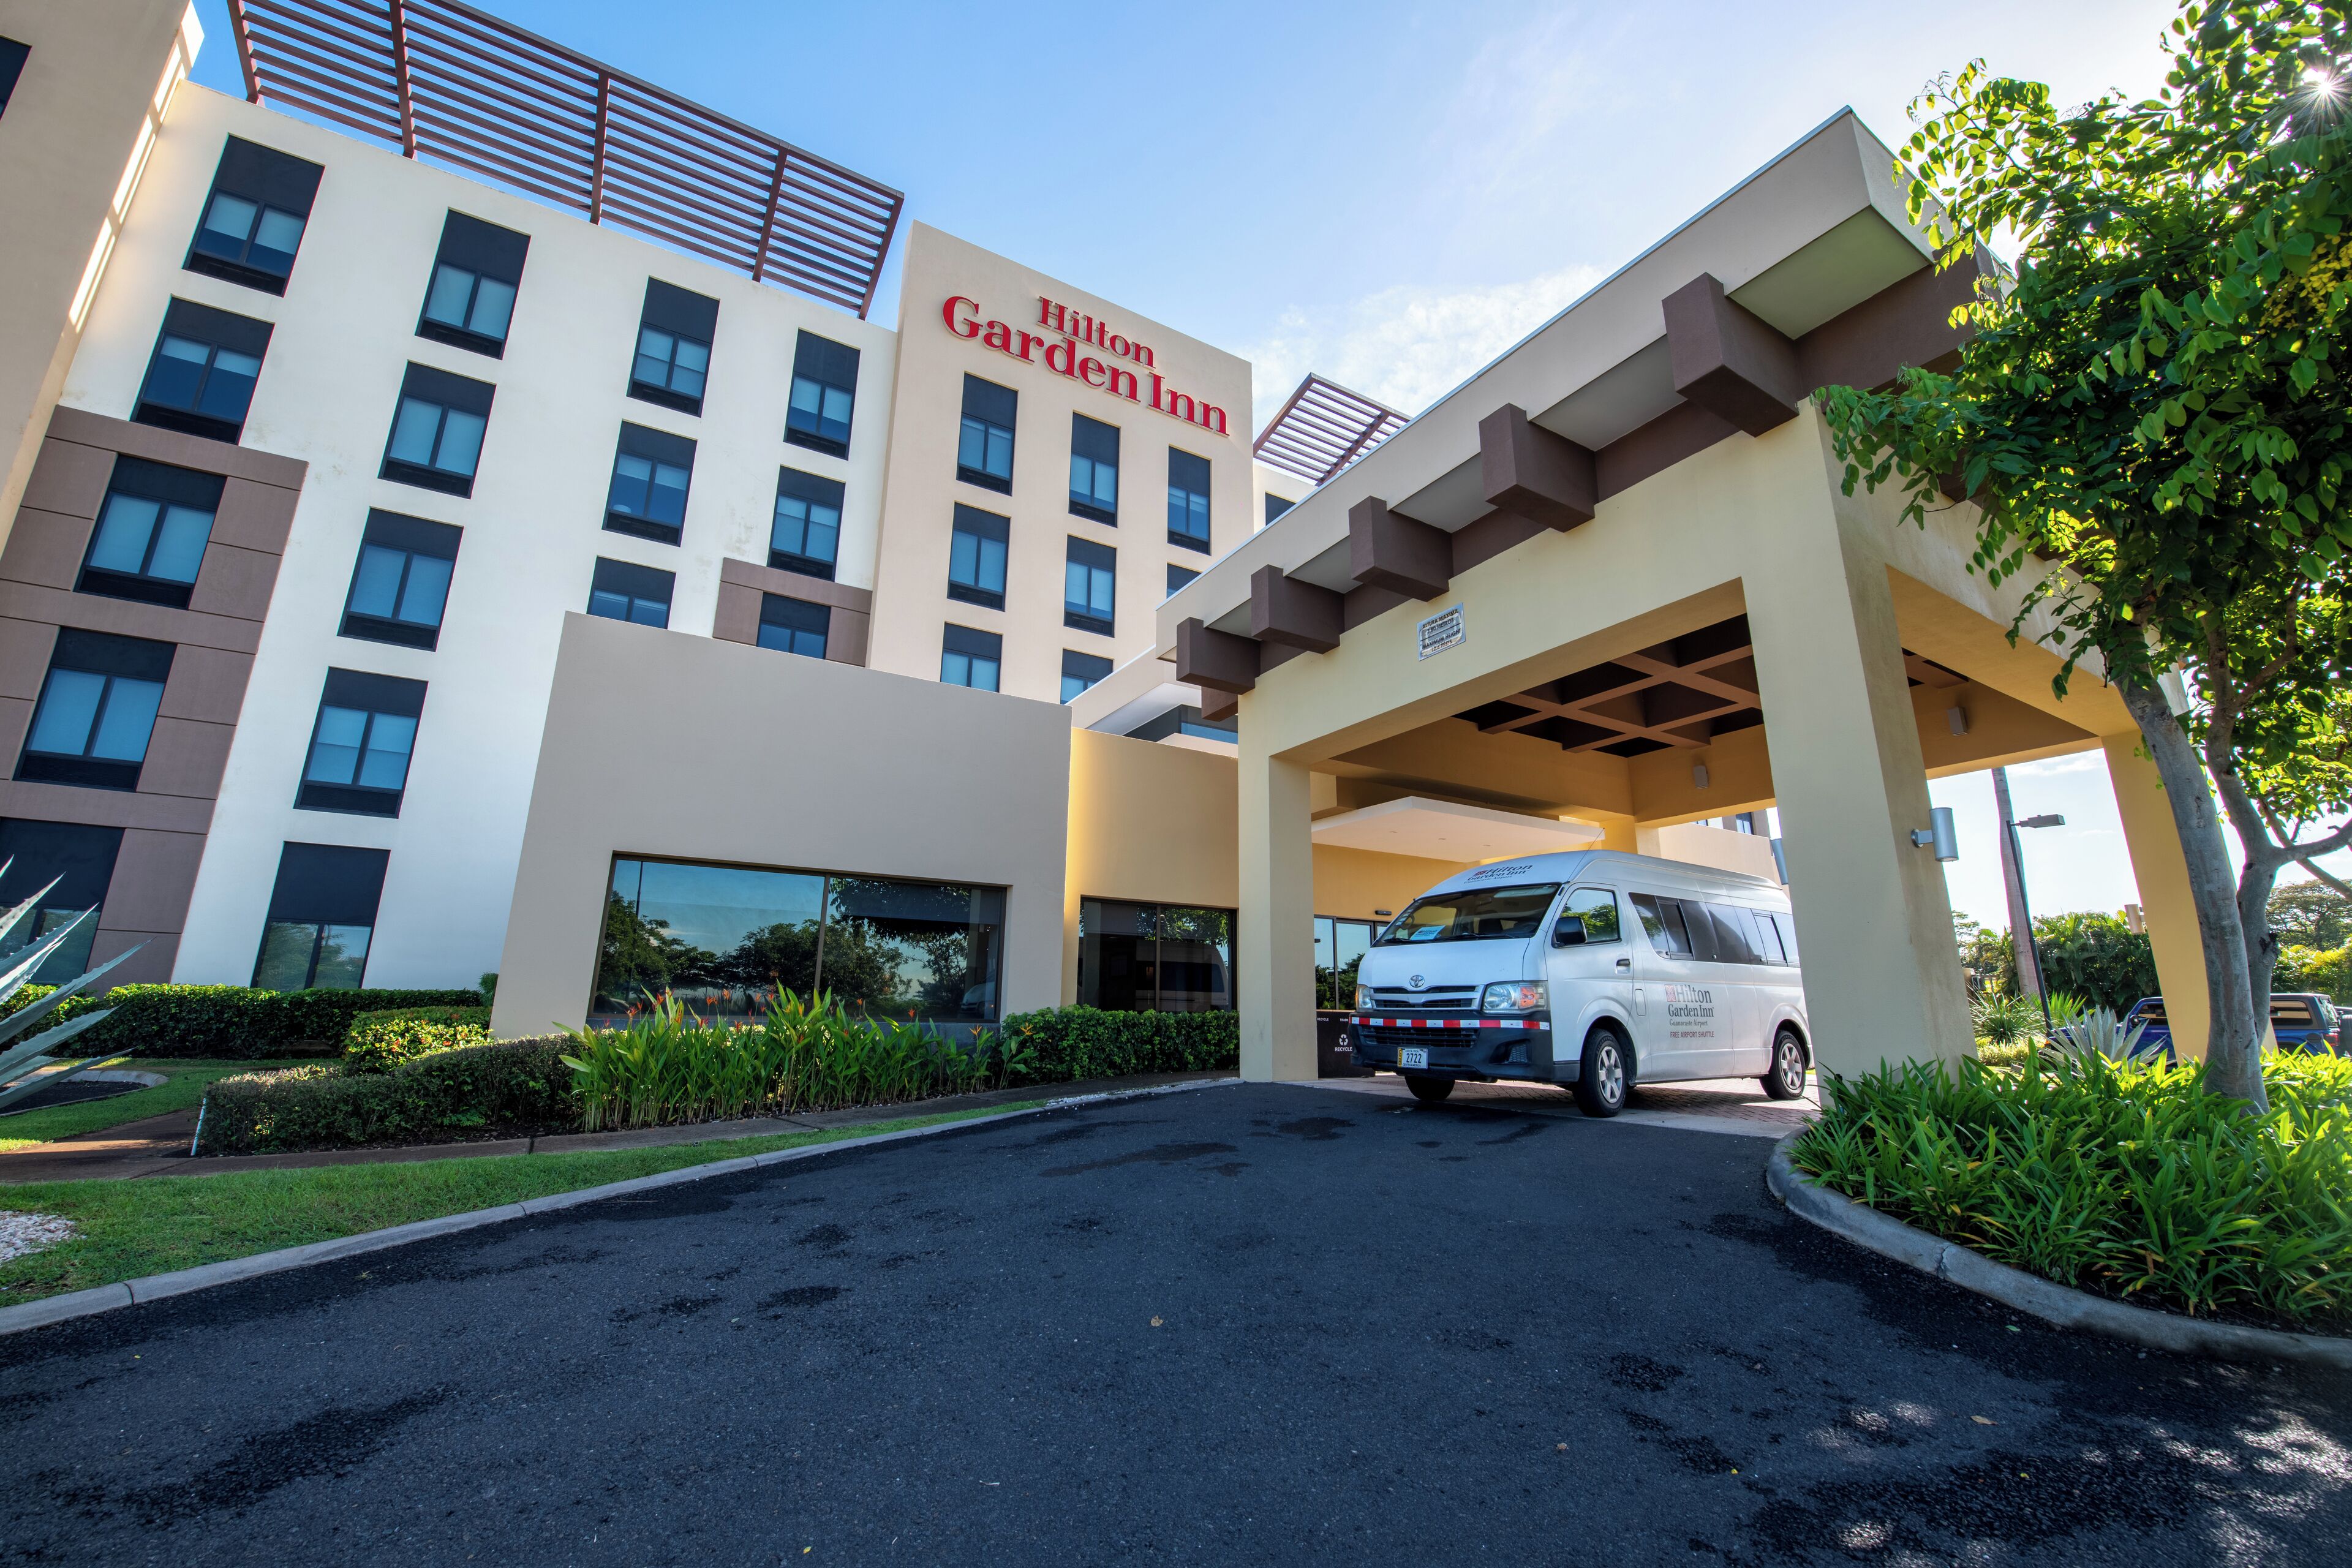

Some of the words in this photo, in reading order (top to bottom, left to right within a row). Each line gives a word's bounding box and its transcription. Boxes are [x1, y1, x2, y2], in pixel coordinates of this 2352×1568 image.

[1038, 296, 1156, 369] Hilton
[942, 295, 1141, 404] Garden
[1147, 371, 1230, 437] Inn
[1422, 619, 1438, 629] ALTURA
[1439, 608, 1458, 622] MAXIMA
[1437, 617, 1454, 629] METROS
[1422, 636, 1445, 649] MAXIMUM
[1446, 628, 1461, 639] HEIGHT
[1467, 872, 1505, 881] Garden
[1484, 865, 1533, 875] Hilton
[1675, 984, 1712, 1003] Hilton
[1668, 1004, 1698, 1017] Garden
[1699, 1005, 1714, 1017] Inn
[1694, 1019, 1708, 1028] Airport
[1406, 1053, 1422, 1063] 2722
